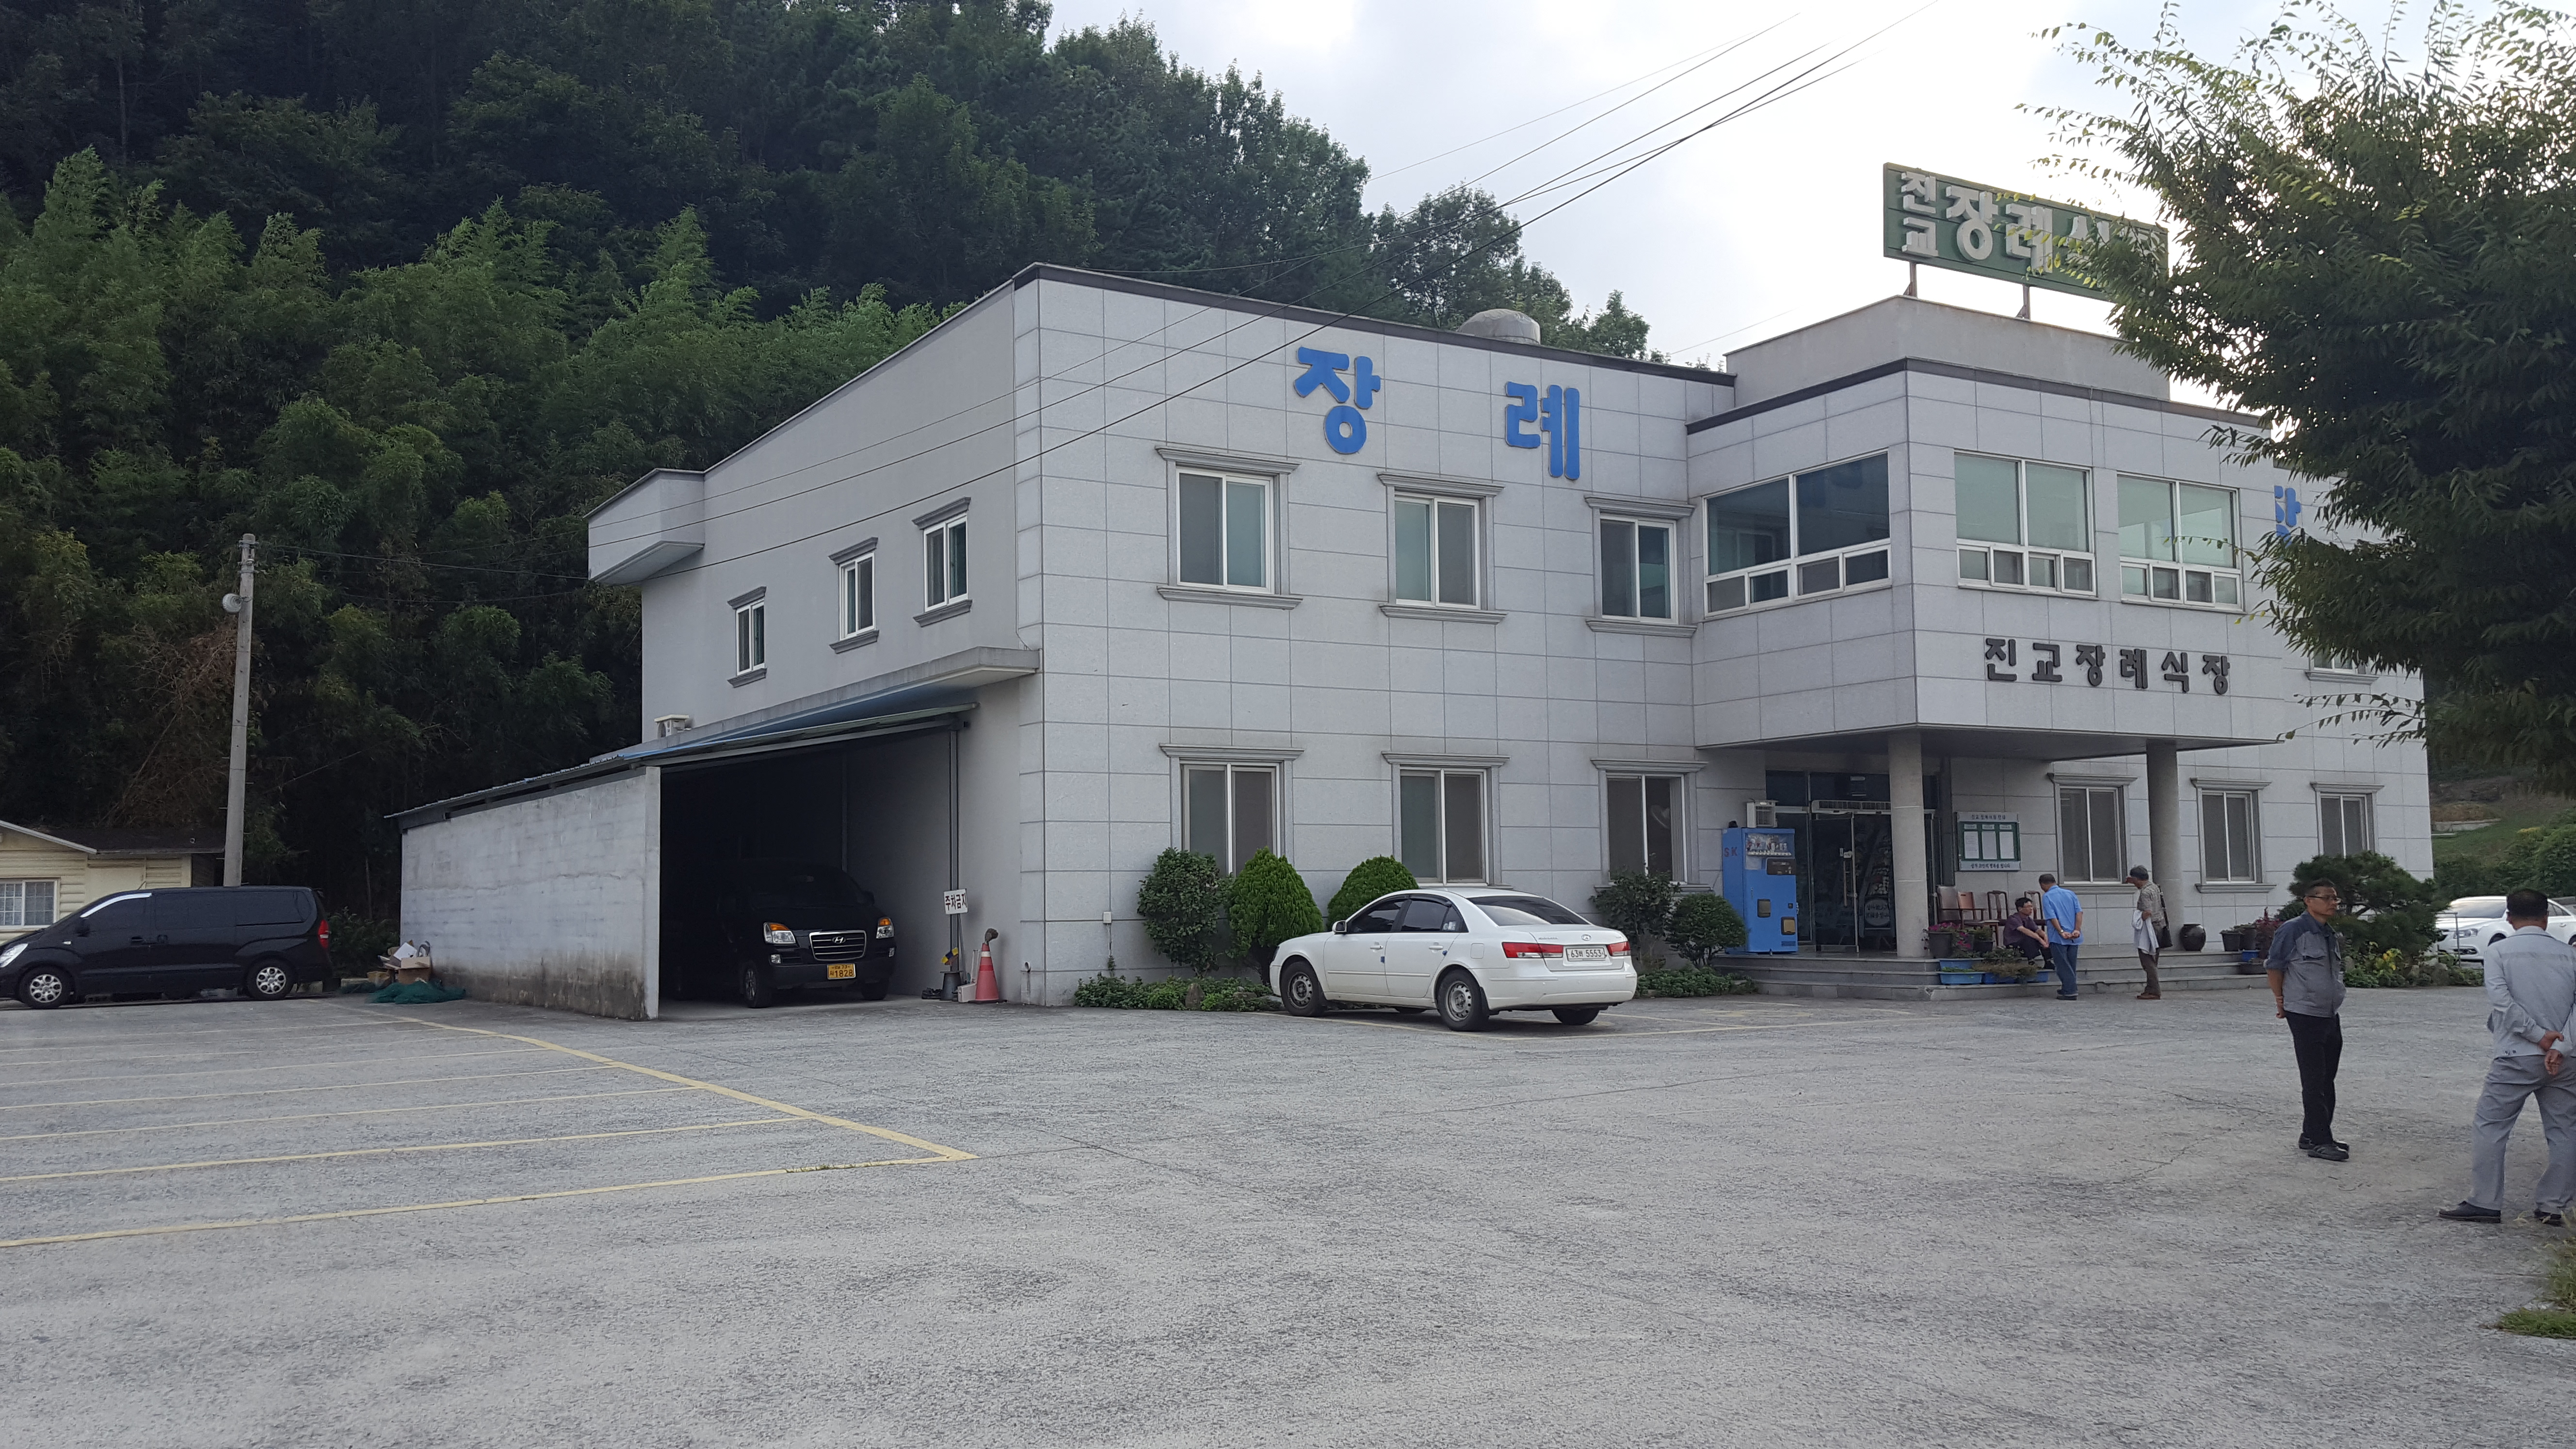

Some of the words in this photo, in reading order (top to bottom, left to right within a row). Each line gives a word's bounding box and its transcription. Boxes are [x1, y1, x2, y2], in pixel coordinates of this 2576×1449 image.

[1901, 171, 1939, 257] 진교
[1293, 346, 1381, 454] 장
[1505, 381, 1580, 480] 례
[1985, 638, 2230, 695] 진교장례식장
[1724, 847, 1738, 857] SK
[945, 893, 967, 911] 주차금지
